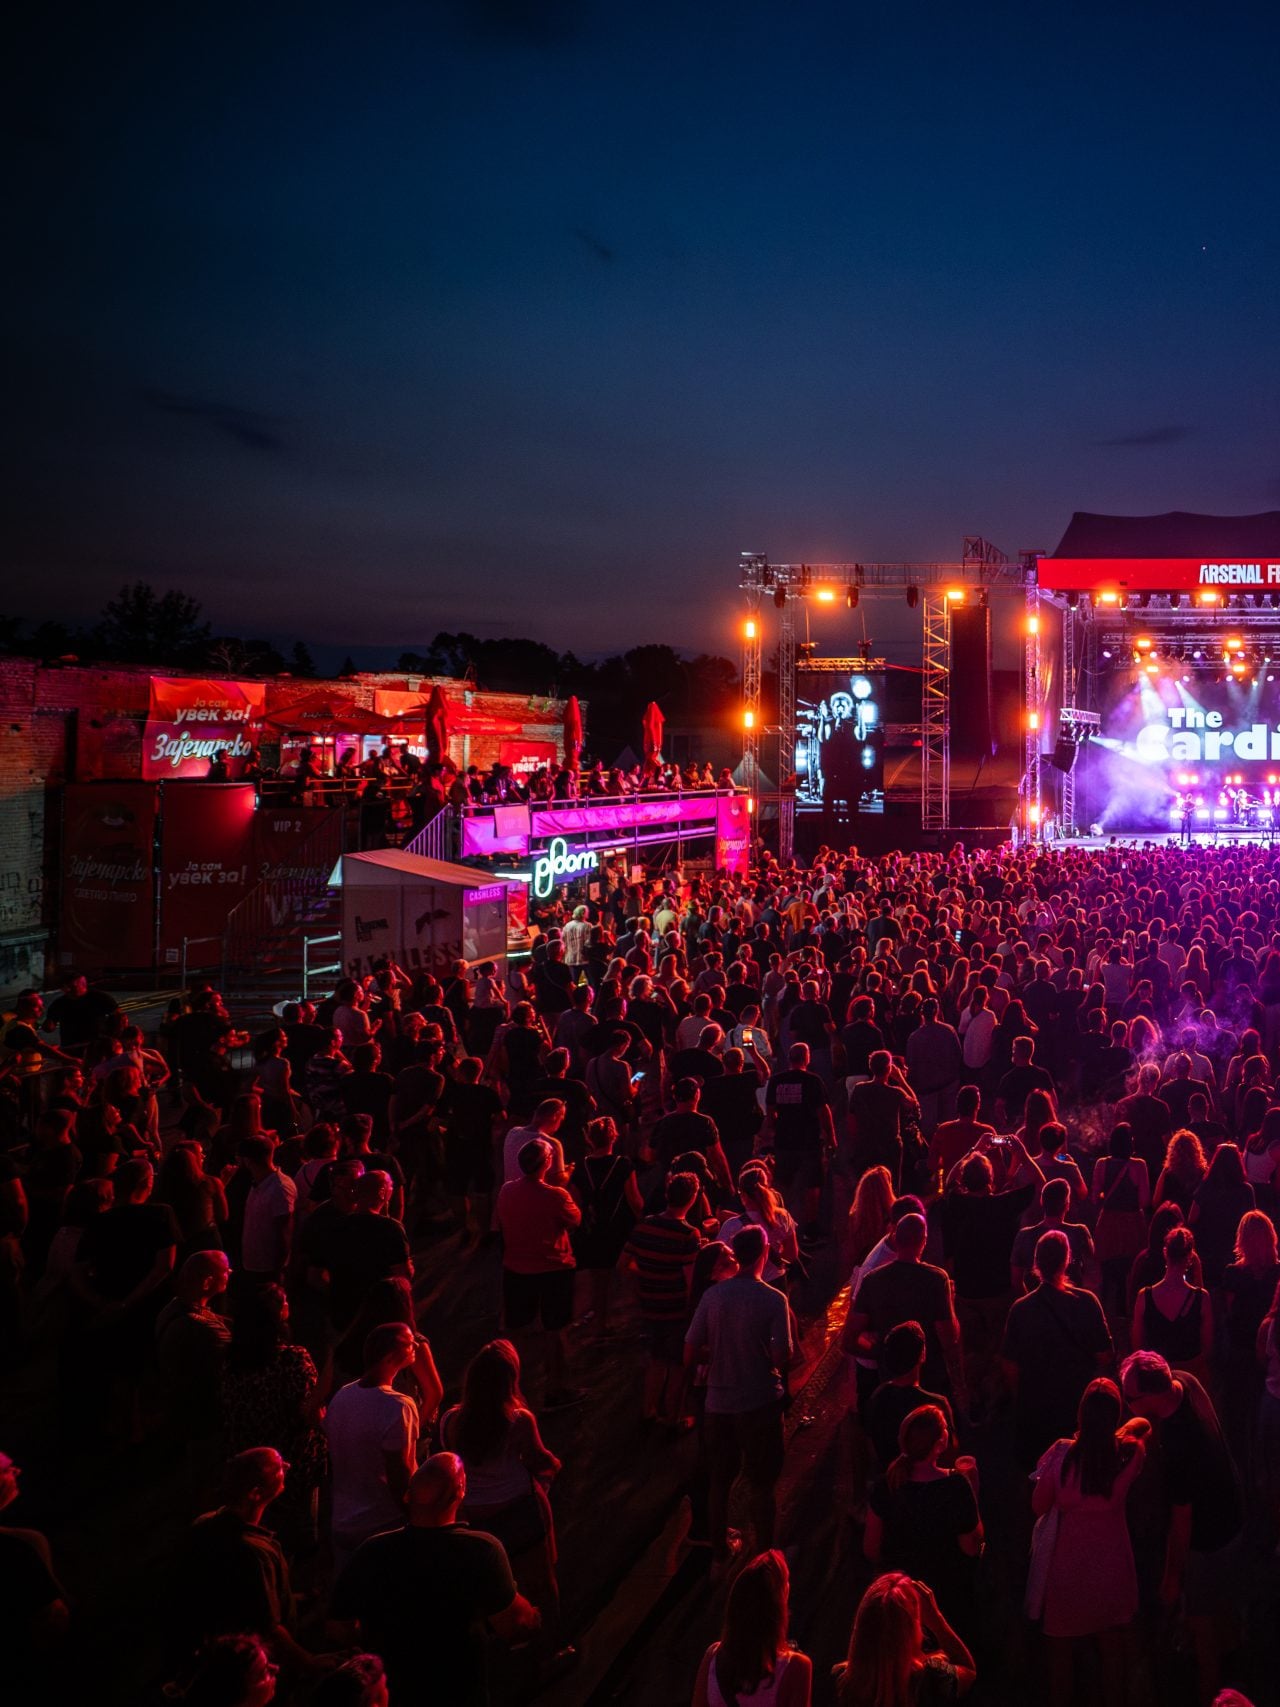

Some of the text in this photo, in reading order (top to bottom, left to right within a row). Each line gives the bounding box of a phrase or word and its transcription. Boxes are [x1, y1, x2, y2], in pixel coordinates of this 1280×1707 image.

[1199, 564, 1264, 584] ARSENAL
[173, 708, 220, 725] увек
[1168, 708, 1222, 728] The
[151, 731, 252, 766] Зајечарско
[273, 820, 302, 832] VIP 2
[168, 865, 248, 890] увек за!
[535, 837, 599, 898] ploom
[469, 887, 501, 902] CASHLESS
[344, 941, 462, 979] CALESS
